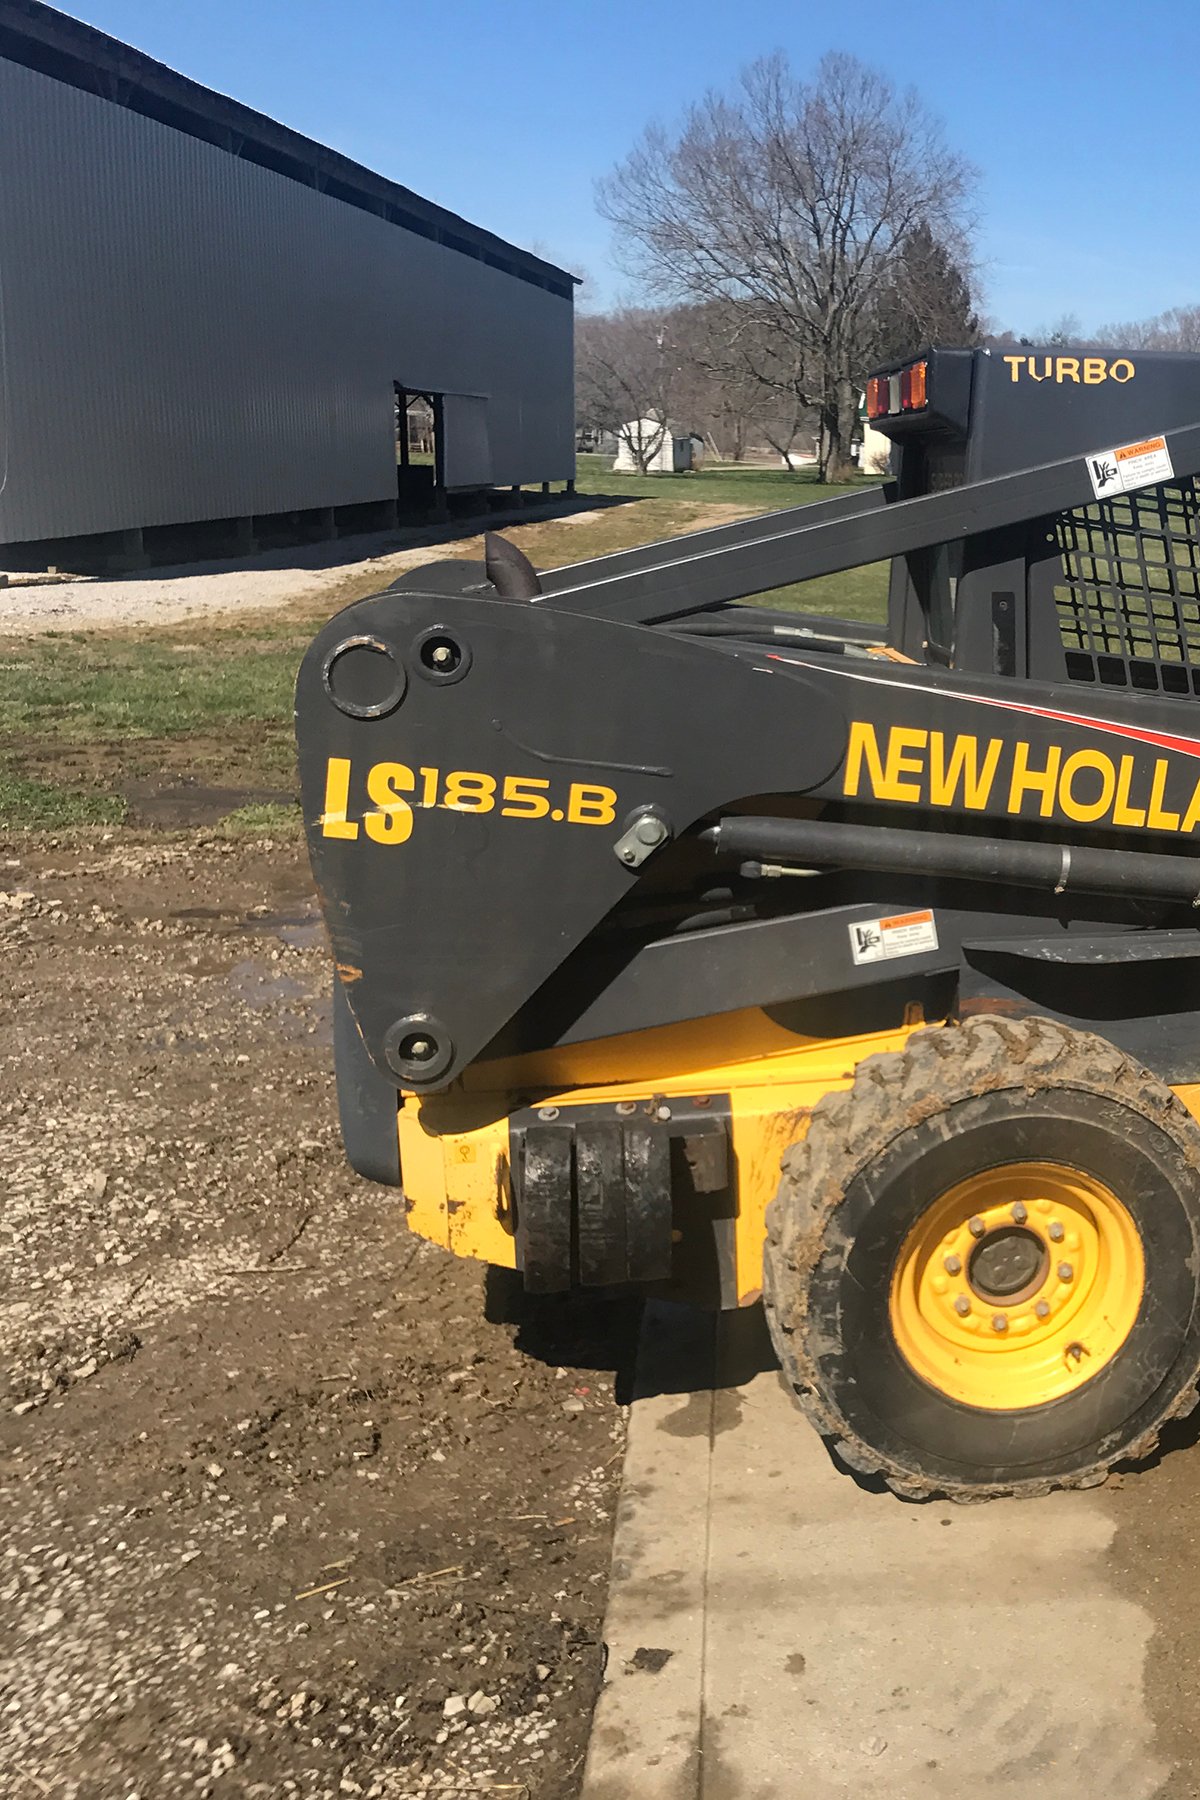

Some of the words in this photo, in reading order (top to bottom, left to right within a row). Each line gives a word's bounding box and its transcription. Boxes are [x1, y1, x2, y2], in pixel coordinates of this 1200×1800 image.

[1003, 356, 1135, 384] TURBO
[1127, 442, 1161, 457] WARNING
[842, 721, 1003, 810] NEW
